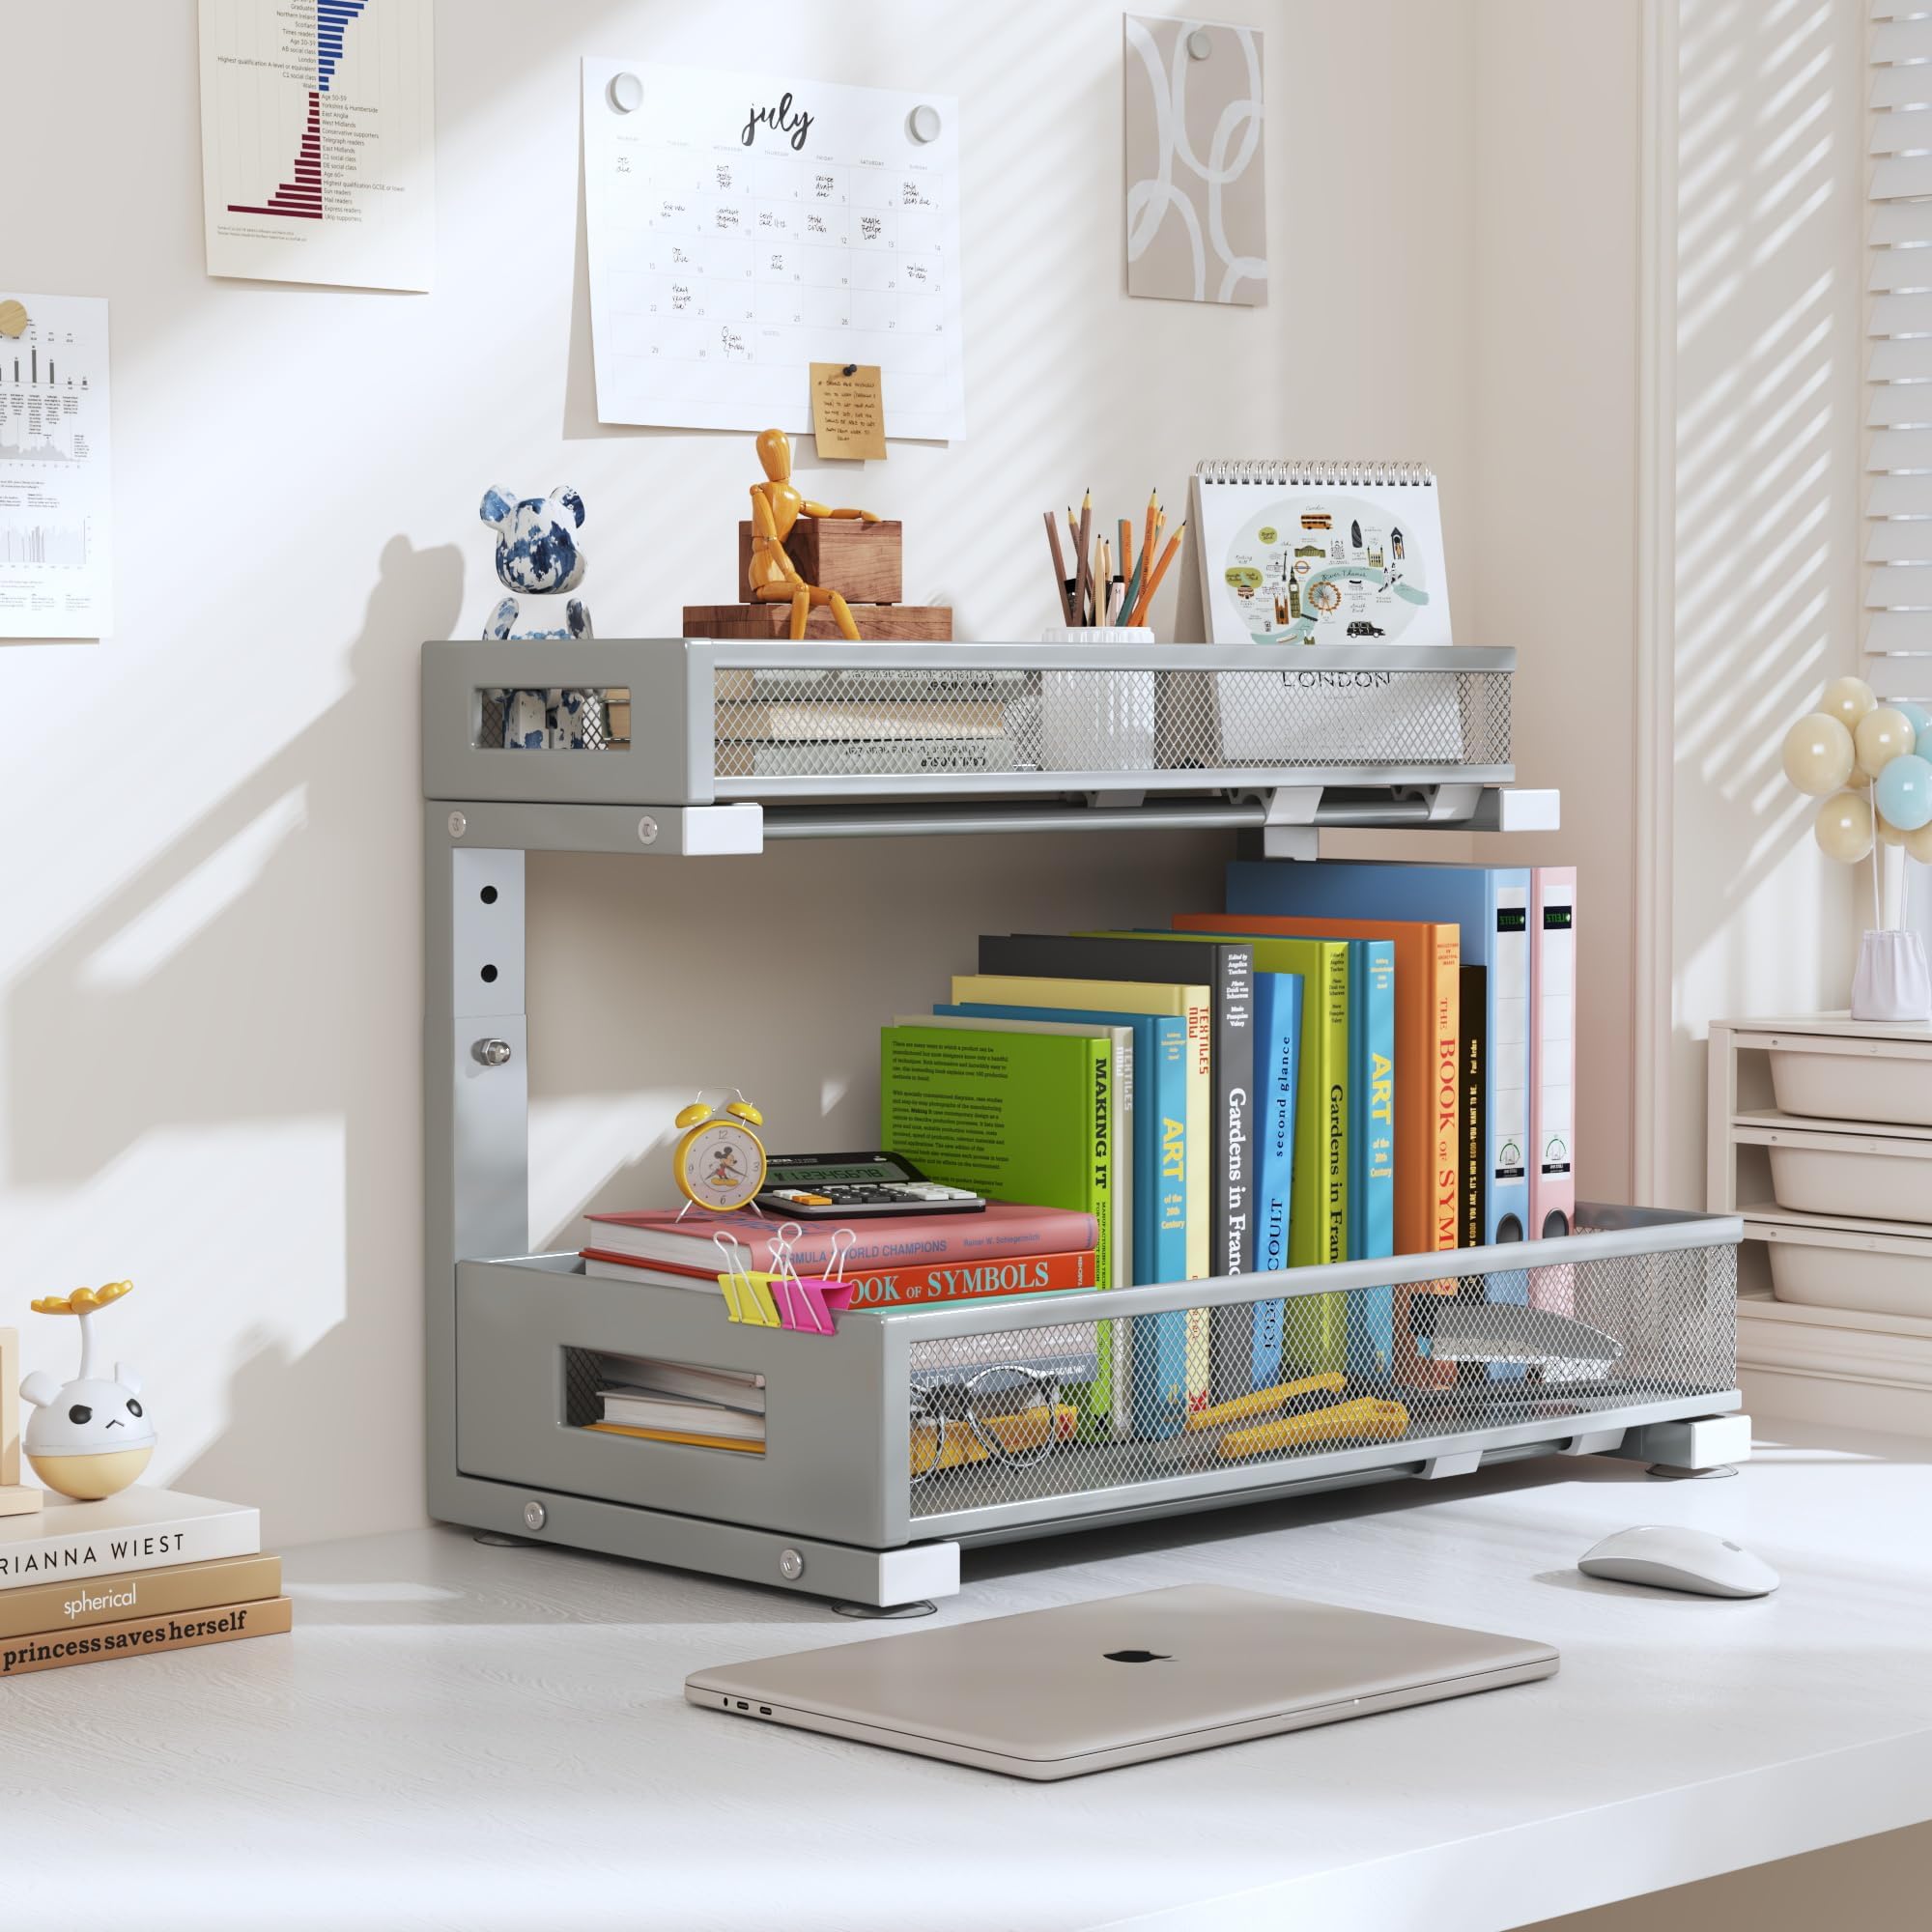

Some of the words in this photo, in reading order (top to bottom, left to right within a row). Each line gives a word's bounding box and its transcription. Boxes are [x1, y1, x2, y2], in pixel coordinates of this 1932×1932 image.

[741, 92, 815, 151] july
[1283, 671, 1390, 688] LONDON
[1199, 1007, 1208, 1075] TEXTILES
[1123, 1047, 1133, 1111] TEXTILES
[1281, 1036, 1291, 1092] glance
[1439, 1038, 1456, 1132] BOOK
[1095, 1058, 1107, 1158] MAKING
[1372, 1053, 1392, 1125] ART
[719, 1129, 728, 1140] 12
[1229, 1088, 1246, 1181] Gardens
[1276, 1097, 1287, 1157] second
[1330, 1084, 1344, 1177] Gardens
[1373, 1139, 1379, 1150] of
[1380, 1139, 1389, 1149] the
[688, 1164, 694, 1174] 9
[753, 1162, 760, 1172] 3
[1163, 1118, 1184, 1182] ART
[1439, 1141, 1447, 1161] OF
[790, 1168, 883, 1180] 12345678
[1095, 1165, 1107, 1189] IT
[1330, 1182, 1343, 1204] in
[1370, 1167, 1392, 1179] Century
[720, 1196, 726, 1206] 6
[1164, 1195, 1171, 1206] of
[1172, 1194, 1182, 1205] the
[1229, 1186, 1246, 1208] in
[1438, 1170, 1455, 1251] SYM
[1161, 1219, 1186, 1230] Century
[1229, 1212, 1246, 1275] Franc
[1267, 1198, 1283, 1271] COULT
[1329, 1208, 1343, 1264] Fran
[773, 1251, 827, 1265] ORMULA
[840, 1245, 878, 1260] WORLD
[882, 1239, 947, 1256] CHAMPIONS
[850, 1275, 900, 1304] OOK
[906, 1287, 923, 1299] OF
[927, 1262, 1049, 1297] SYMBOLS
[0, 1547, 97, 1575] RIANNA
[111, 1533, 185, 1559] WIEST
[63, 1583, 137, 1620] spherical
[3, 1634, 101, 1671] princess
[104, 1628, 166, 1650] saves
[168, 1610, 248, 1640] herself
